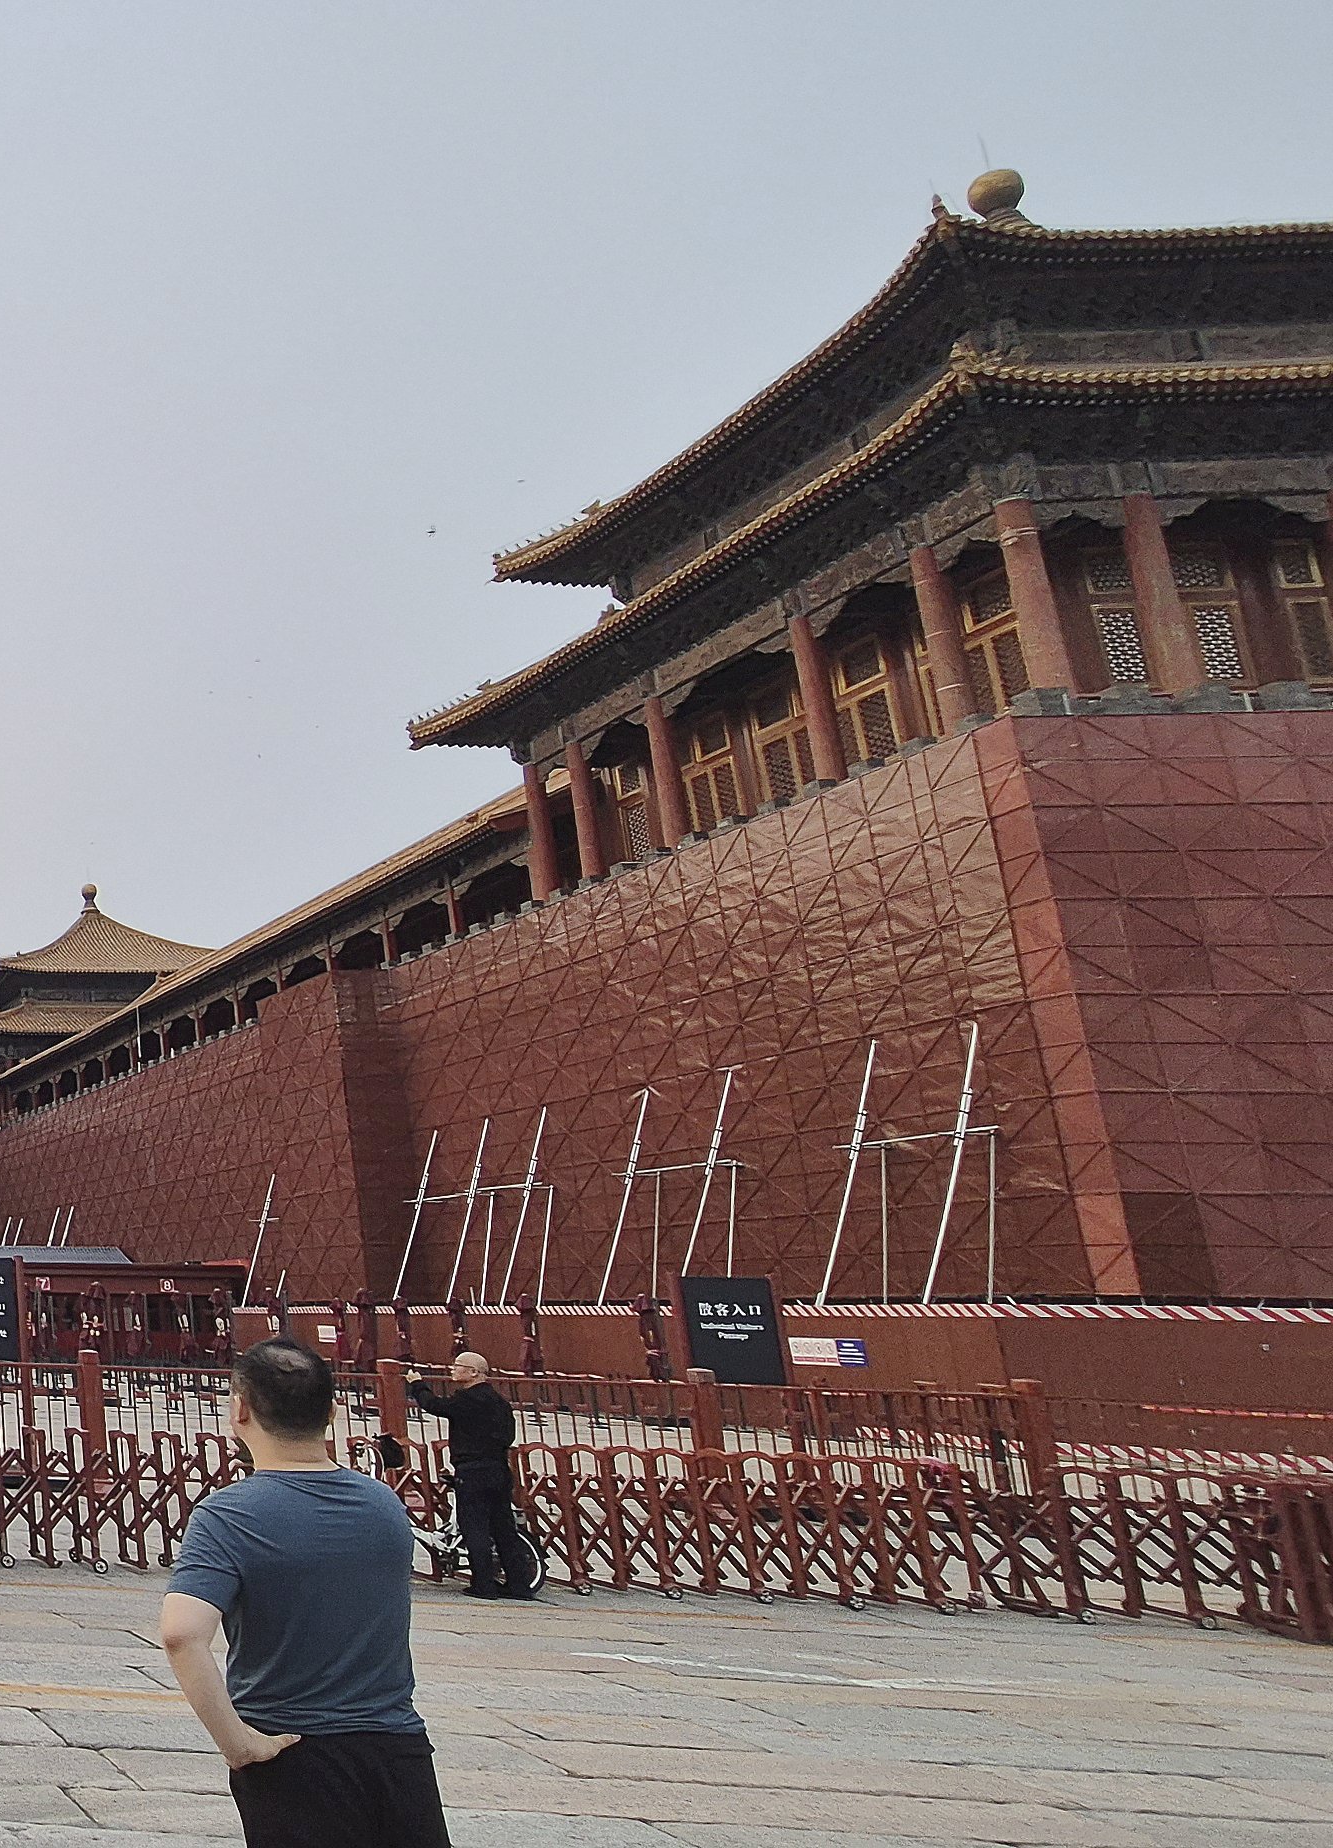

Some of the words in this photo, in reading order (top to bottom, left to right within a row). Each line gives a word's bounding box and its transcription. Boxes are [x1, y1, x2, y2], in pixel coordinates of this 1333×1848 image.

[698, 1302, 762, 1317] 散客入口
[700, 1322, 736, 1330] Individual
[736, 1323, 765, 1331] Visitors
